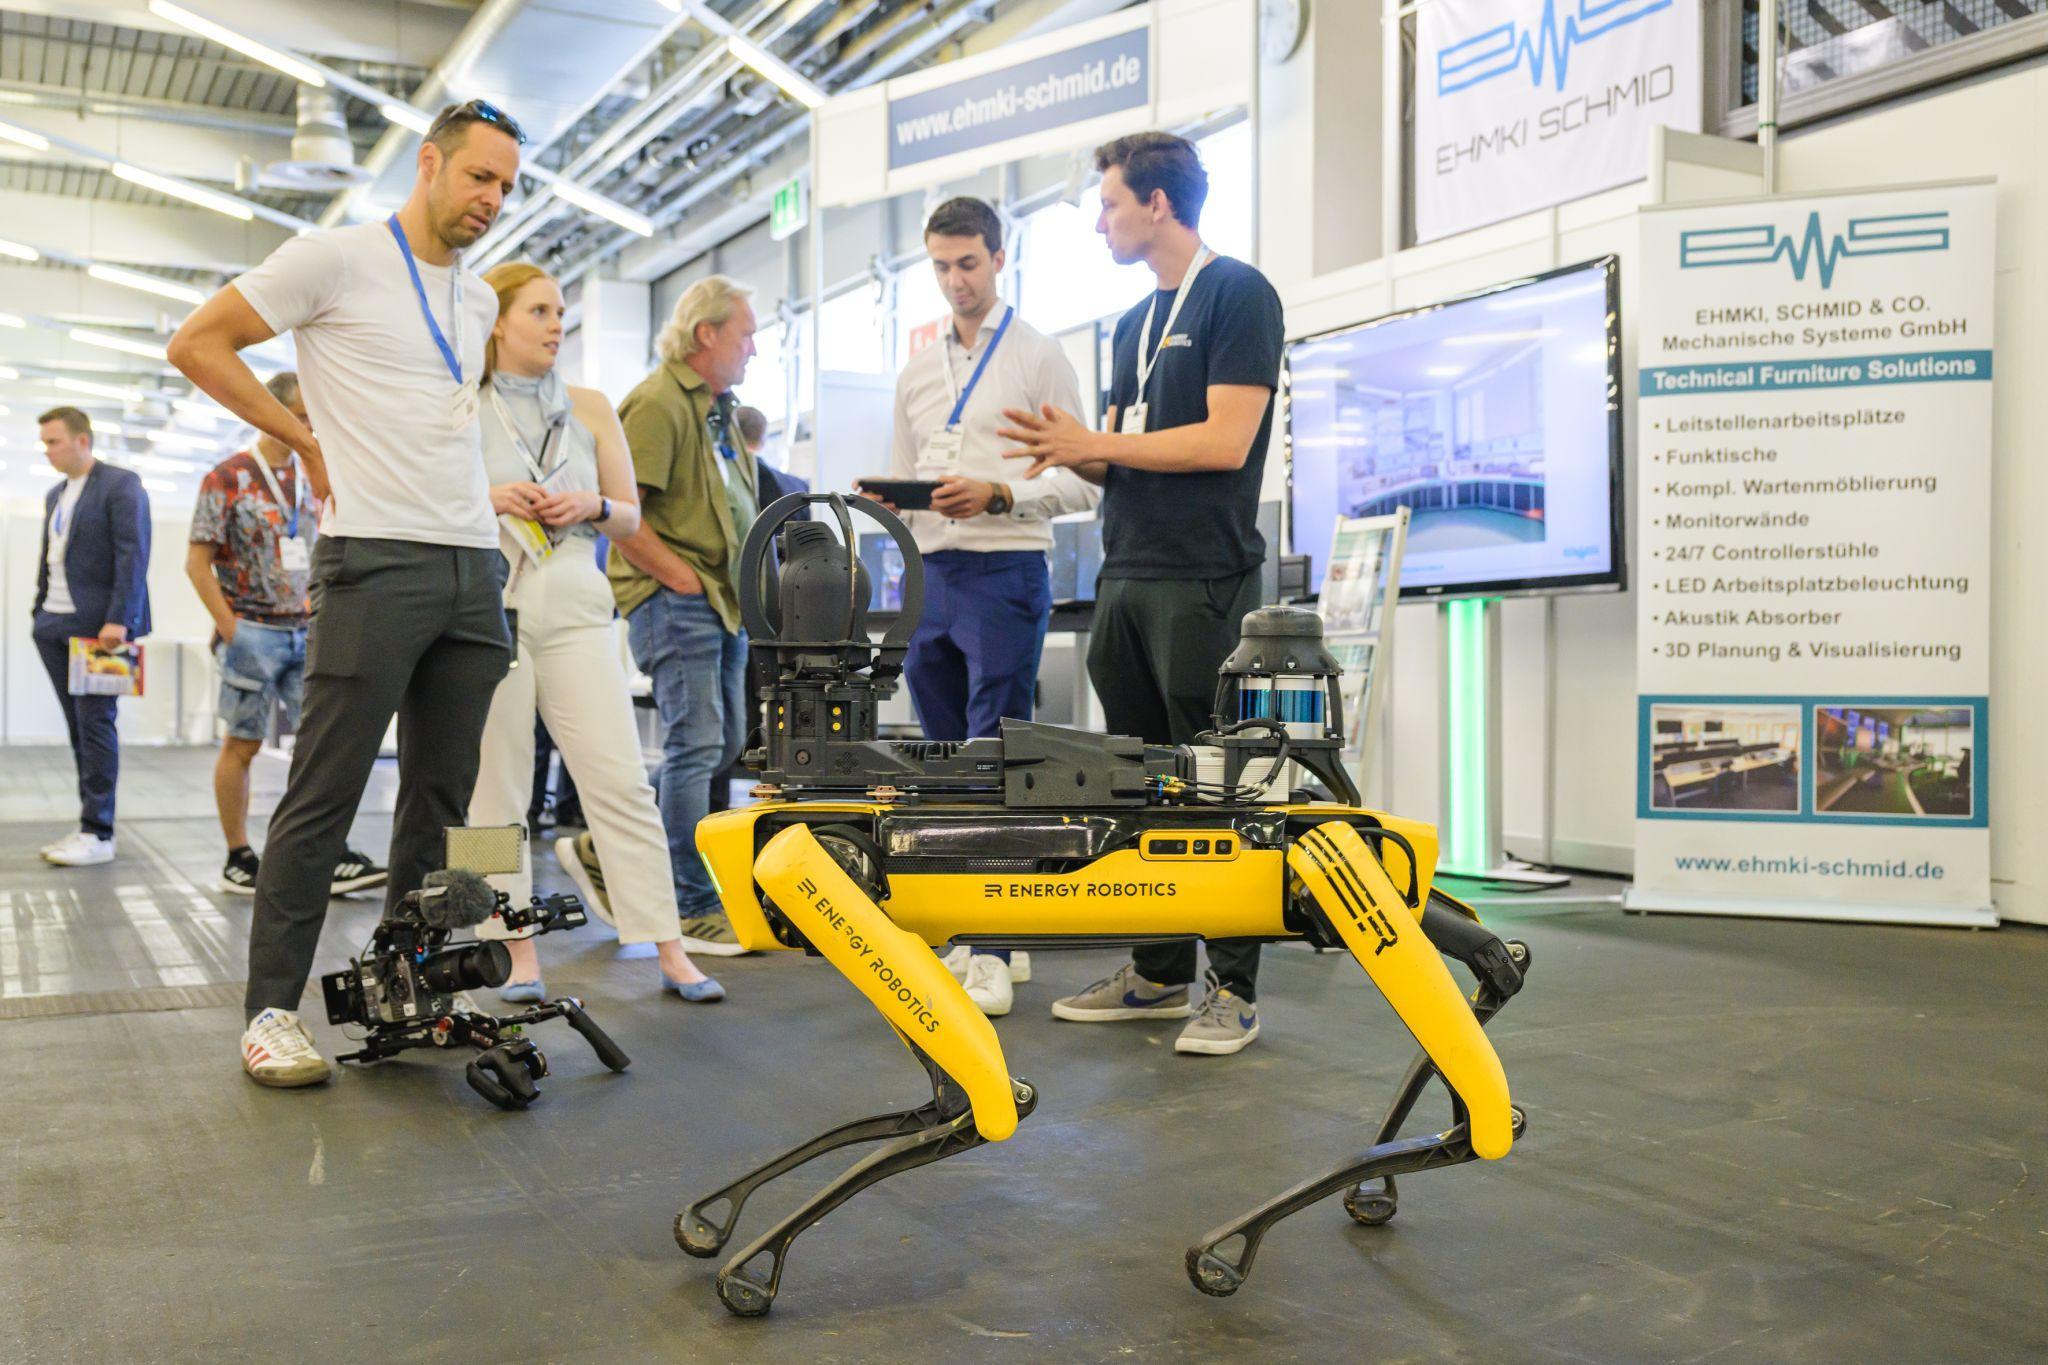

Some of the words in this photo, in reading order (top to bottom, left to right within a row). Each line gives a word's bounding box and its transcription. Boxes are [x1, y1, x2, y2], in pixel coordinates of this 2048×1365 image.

[896, 52, 1141, 146] www.ehmki-schmid.de
[1436, 118, 1528, 175] EHMKI
[1539, 64, 1673, 140] SCHMID
[1696, 307, 1769, 326] EHMKI,
[1776, 300, 1862, 321] SCHMID
[1869, 299, 1884, 315] &
[1892, 295, 1930, 313] CO.
[1662, 330, 1794, 351] Mechanische
[1802, 324, 1892, 347] Systeme
[1900, 319, 1968, 338] GmbH
[1653, 369, 1753, 391] Technical
[1760, 363, 1861, 385] Furniture
[1868, 357, 1977, 380] Solutions
[1667, 409, 1905, 433] Leitstellenarbeitsplätze
[1667, 446, 1777, 465] Funktische
[1667, 480, 1736, 499] Kompl.
[1743, 474, 1938, 495] Wartenmöblierung
[1666, 512, 1809, 530] Monitorwände
[1666, 545, 1705, 562] 24/7
[1712, 543, 1879, 561] Controllerstühle
[1666, 578, 1705, 594] LED
[1713, 574, 1969, 596] Arbeitsplatzbeleuchtung
[1664, 610, 1739, 626] Akustik
[1746, 610, 1842, 626] Absorber
[1665, 642, 1690, 658] 3D
[1697, 642, 1781, 662] Planung
[1788, 642, 1802, 658] &
[1810, 642, 1962, 662] Visualisierung
[1675, 855, 1944, 879] www.ehmki-schmid.de
[1010, 883, 1080, 897] ENERGY
[1087, 883, 1177, 897] ROBOTICS
[869, 957, 939, 1033] ROBOTICS
